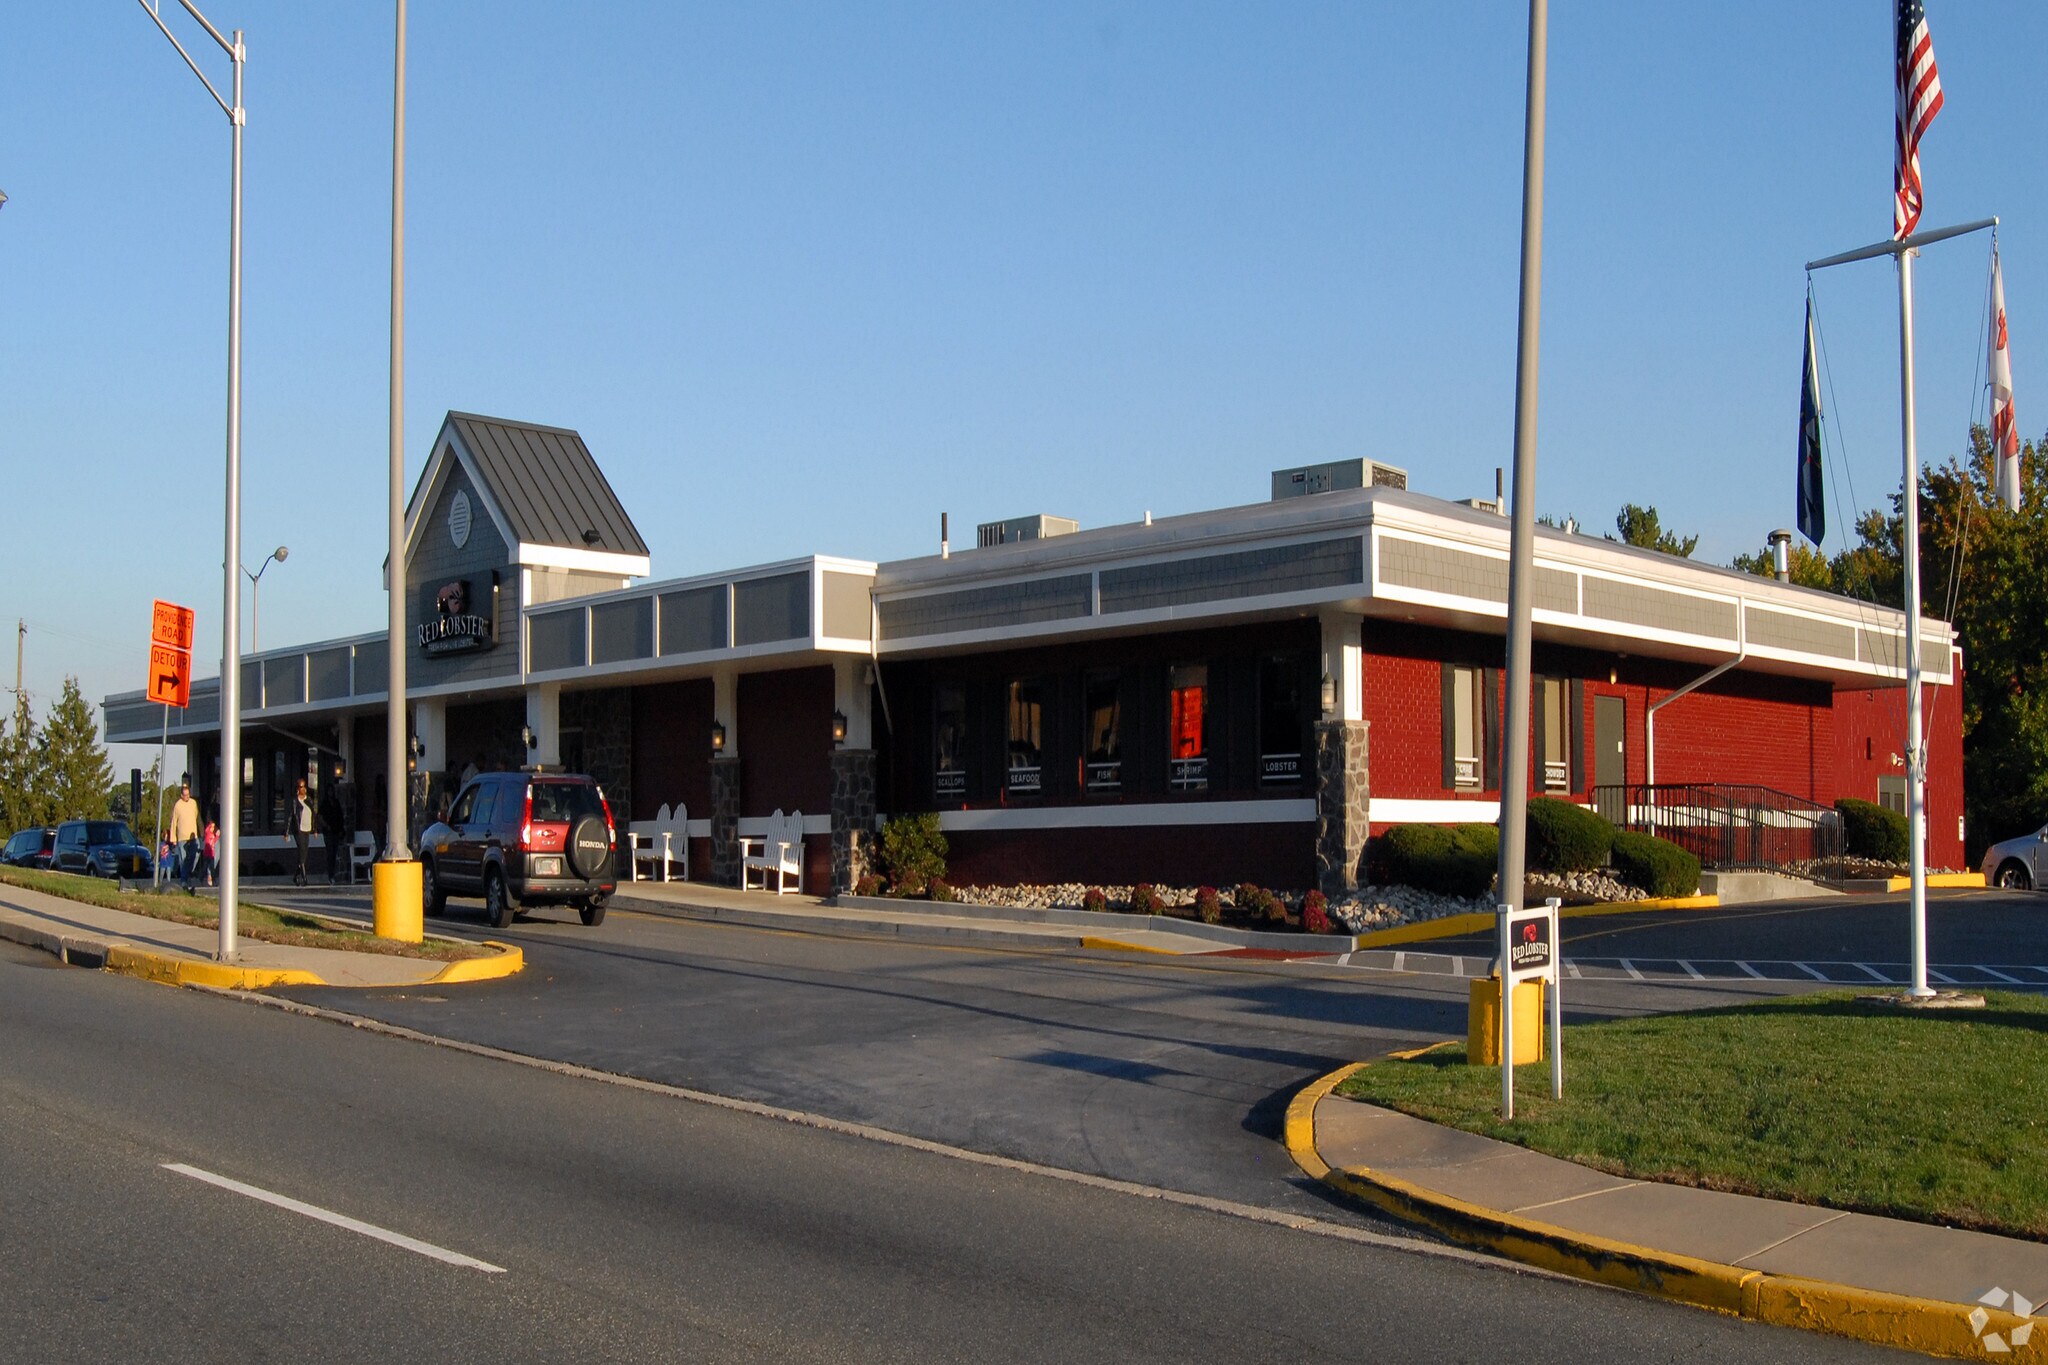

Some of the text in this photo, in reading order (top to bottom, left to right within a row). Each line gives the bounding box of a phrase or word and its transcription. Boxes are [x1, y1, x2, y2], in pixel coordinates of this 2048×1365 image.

[157, 608, 192, 630] PROVIDENCE
[161, 625, 184, 641] ROAD
[417, 621, 440, 647] RED
[440, 614, 485, 638] LOBSTER
[153, 650, 188, 671] DETOUR
[1176, 765, 1202, 776] SHRIMP
[1265, 761, 1298, 772] LOBSTER
[1010, 773, 1041, 784] SEAFOOD
[1096, 769, 1112, 780] FISH
[937, 776, 965, 787] SCALLOPS
[579, 839, 606, 849] HONDA
[1512, 944, 1525, 962] RED
[1524, 941, 1549, 957] LOBSTER
